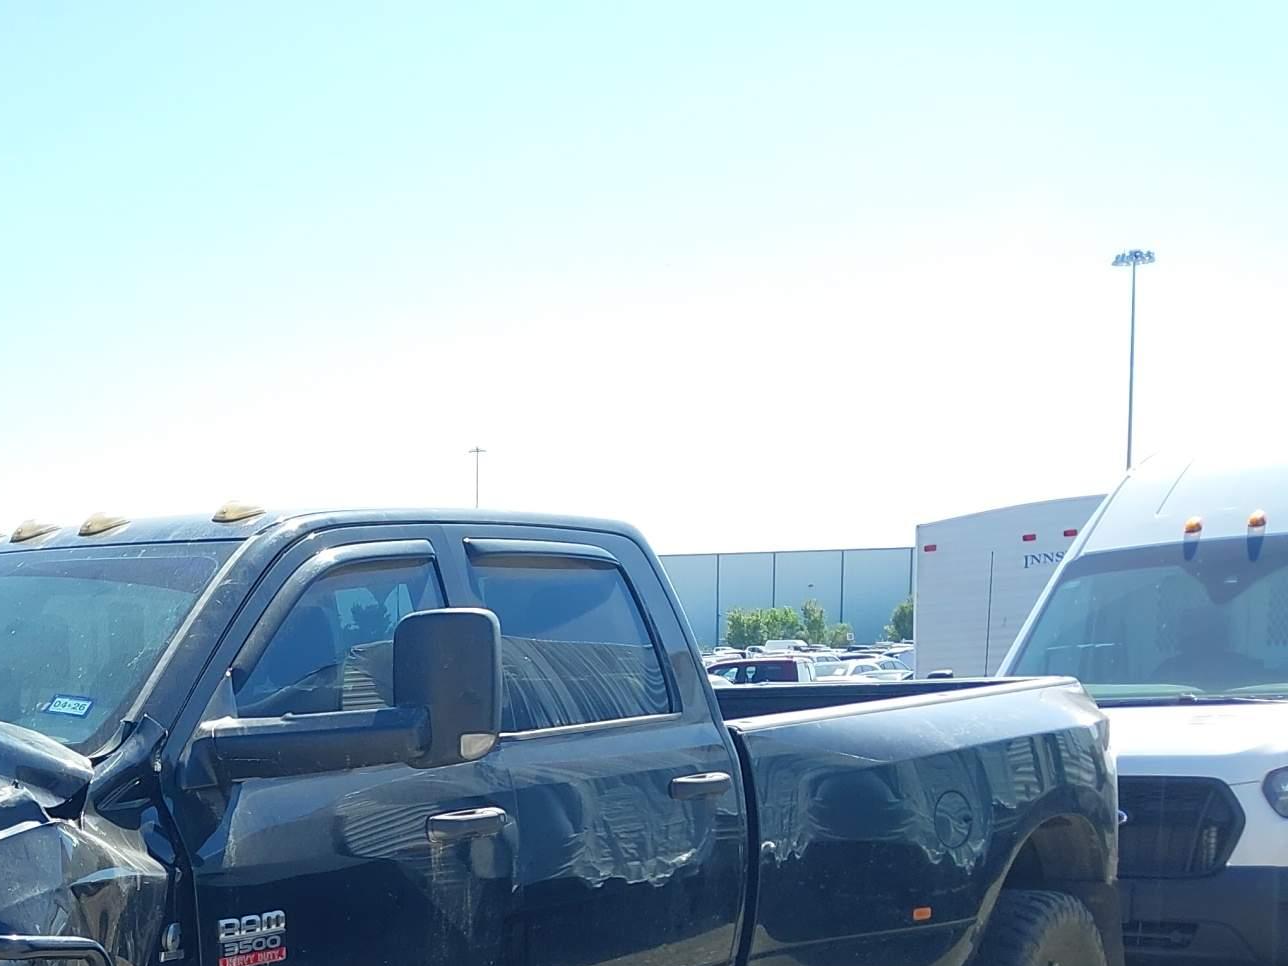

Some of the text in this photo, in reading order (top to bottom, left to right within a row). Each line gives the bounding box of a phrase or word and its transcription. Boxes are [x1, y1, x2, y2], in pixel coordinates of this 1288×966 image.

[1024, 551, 1067, 568] INNS
[219, 910, 286, 938] RAM
[224, 935, 281, 957] 3500
[257, 949, 281, 962] DUTY
